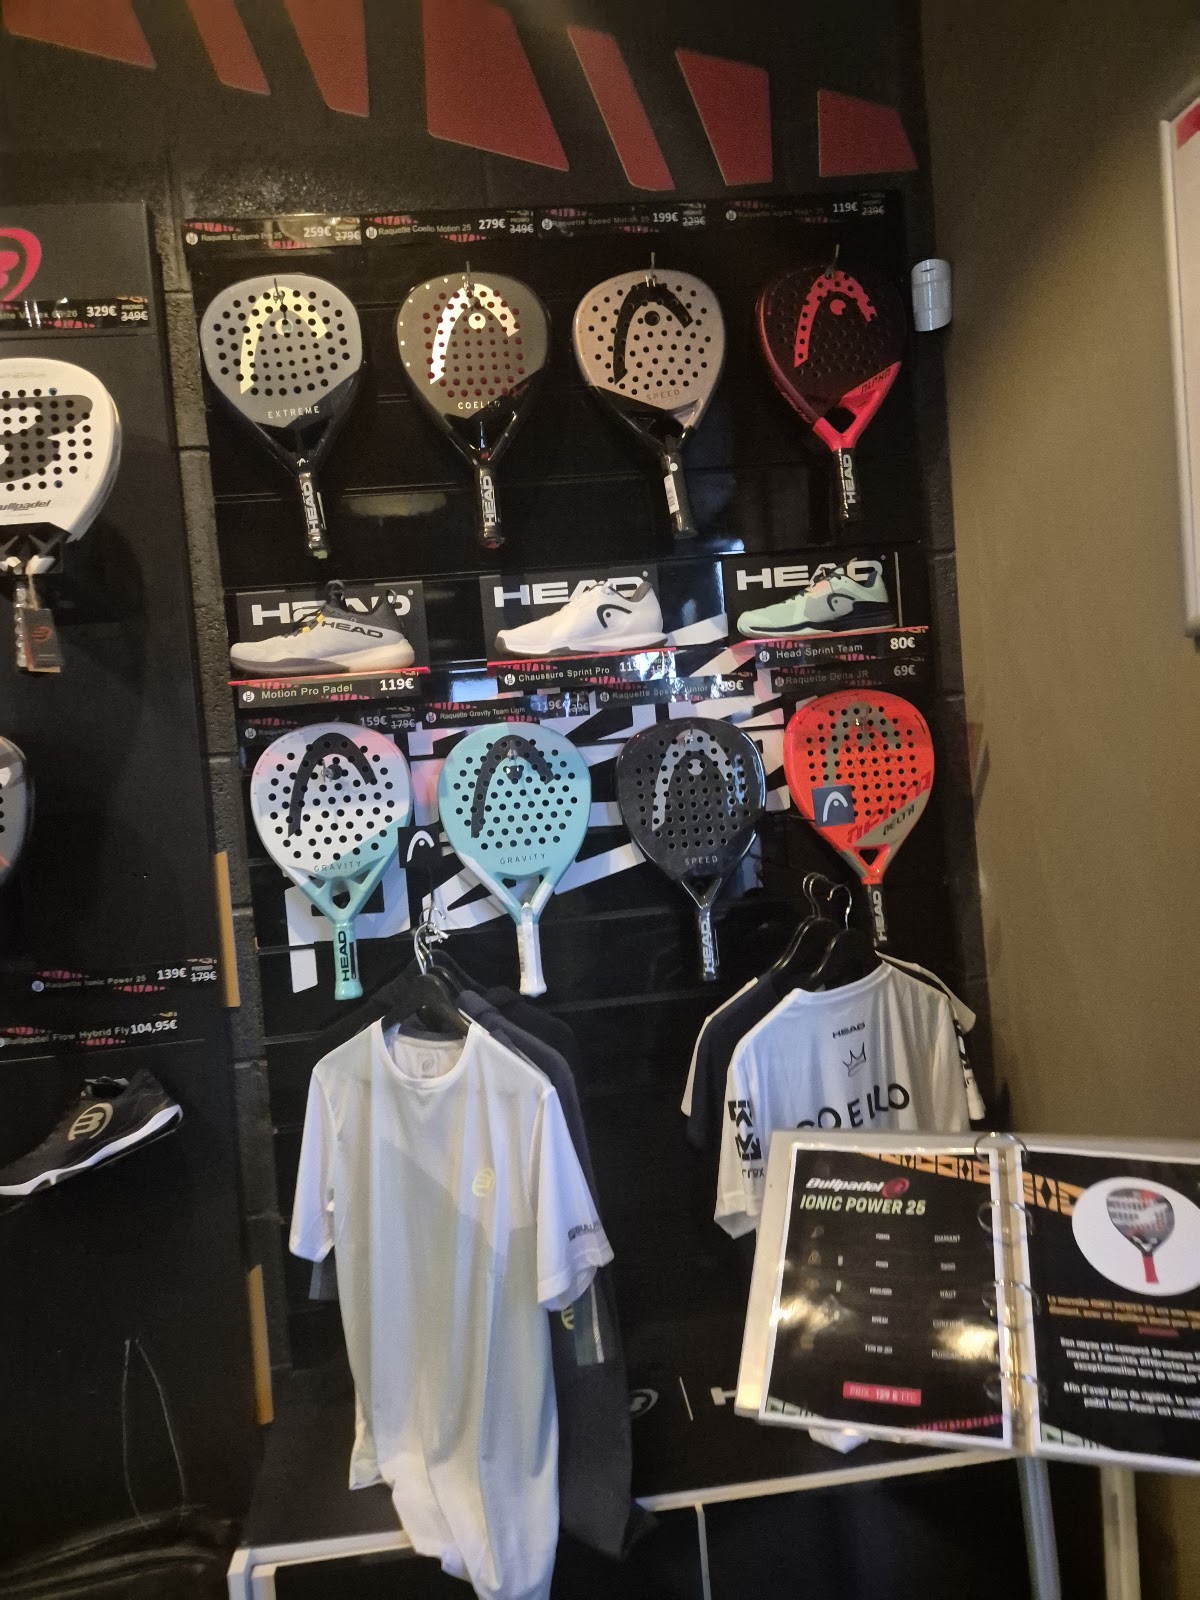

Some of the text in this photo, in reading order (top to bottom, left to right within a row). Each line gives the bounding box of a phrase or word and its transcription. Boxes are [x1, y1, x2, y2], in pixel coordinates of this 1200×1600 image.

[478, 218, 506, 231] 279€
[653, 212, 679, 223] 199€
[303, 226, 332, 238] 259€
[86, 305, 118, 318] 329€
[267, 405, 321, 419] EXTREME
[842, 454, 857, 504] HEAD
[302, 481, 320, 535] HEAD
[482, 475, 496, 527] HEAD
[321, 621, 384, 638] HEAD
[889, 636, 916, 650] 80€
[775, 644, 863, 663] Head Sprint Team
[518, 666, 610, 685] Chaussure Sprint Pro
[893, 664, 917, 677] 69€
[260, 683, 353, 700] Motion Pro Padel
[380, 677, 415, 692] 119€
[360, 715, 388, 727] 159€
[313, 861, 362, 872] GRAVITY
[499, 853, 546, 865] GRAVITY
[338, 931, 350, 982] HEAD
[156, 967, 188, 981] 139€
[79, 1028, 112, 1040] Hybrid
[113, 1026, 130, 1037] Fly
[130, 1018, 178, 1035] 104,95€
[832, 1021, 866, 1039] HEAD
[800, 1194, 843, 1212] IONIC
[845, 1196, 903, 1215] POWER
